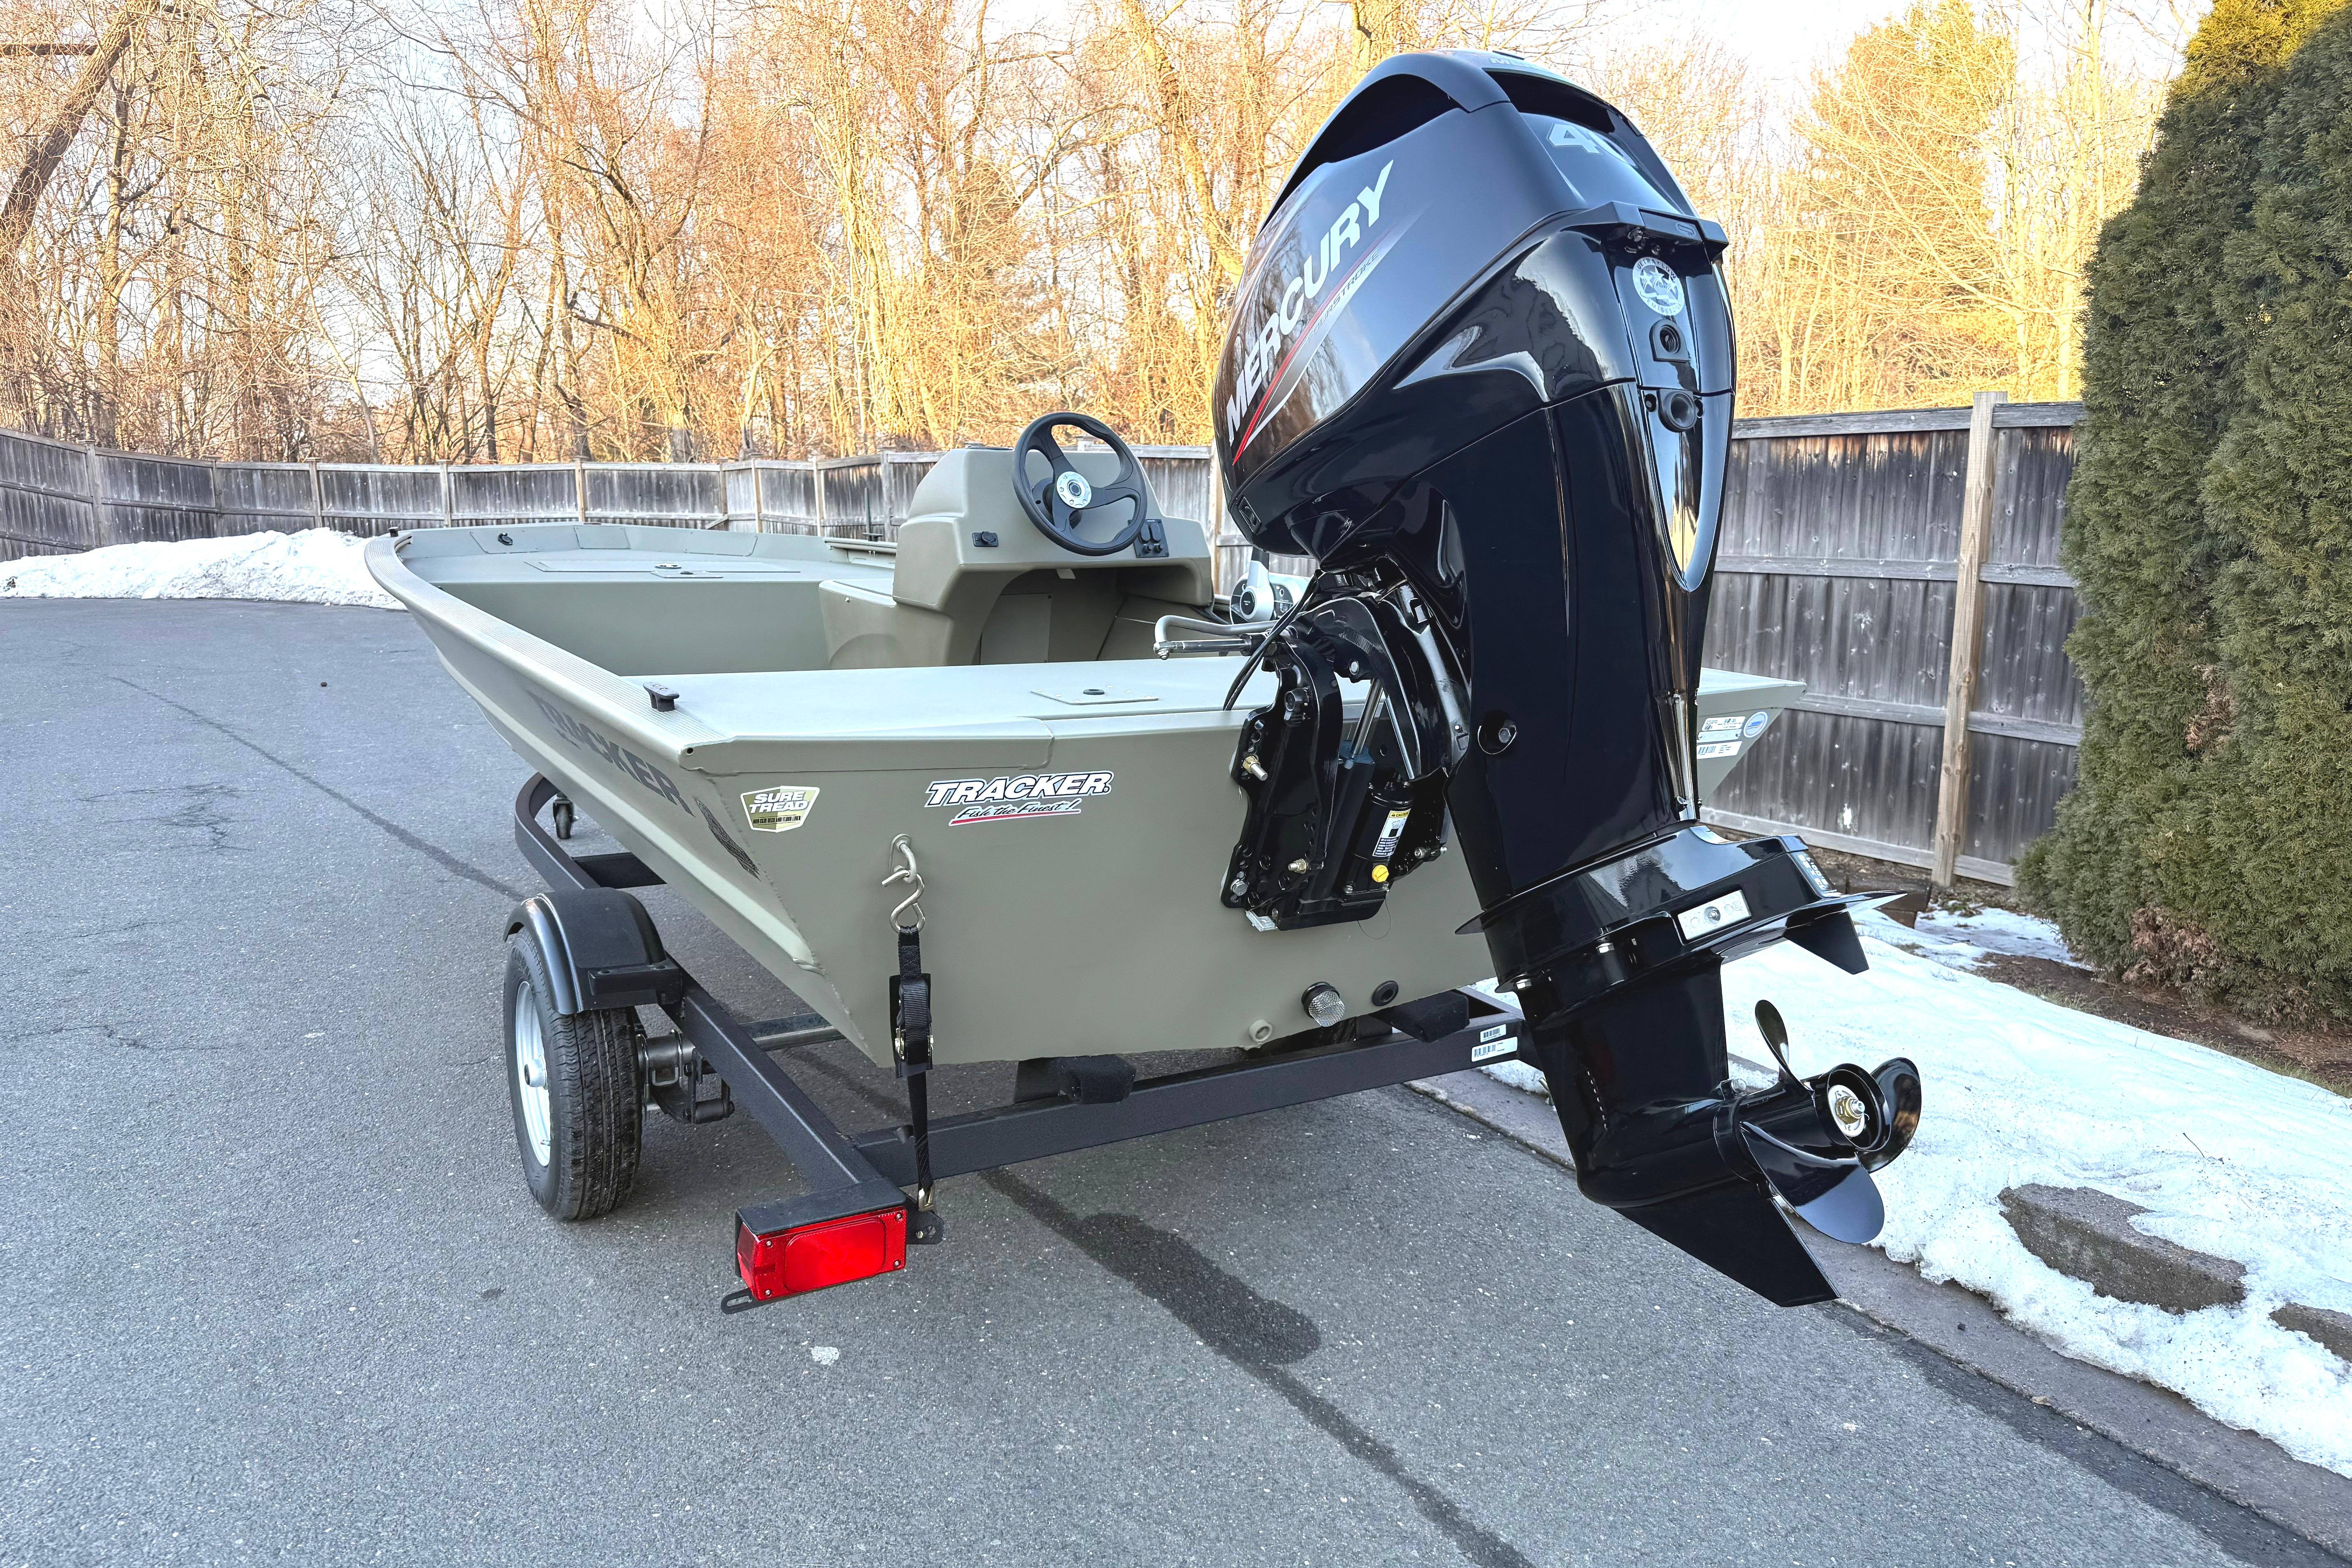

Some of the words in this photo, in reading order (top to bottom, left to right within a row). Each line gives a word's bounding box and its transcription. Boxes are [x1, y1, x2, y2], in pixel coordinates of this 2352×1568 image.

[1547, 123, 1637, 167] 40
[1636, 257, 1656, 270] ULTRA
[1661, 263, 1676, 280] LOW
[1226, 159, 1393, 447] MERCURY
[1307, 248, 1379, 343] FOURSTROKE
[524, 685, 696, 818] TRACKER
[749, 800, 809, 814] TREAD
[754, 791, 805, 804] SURE
[957, 808, 992, 819] Fish
[993, 805, 1017, 815] the
